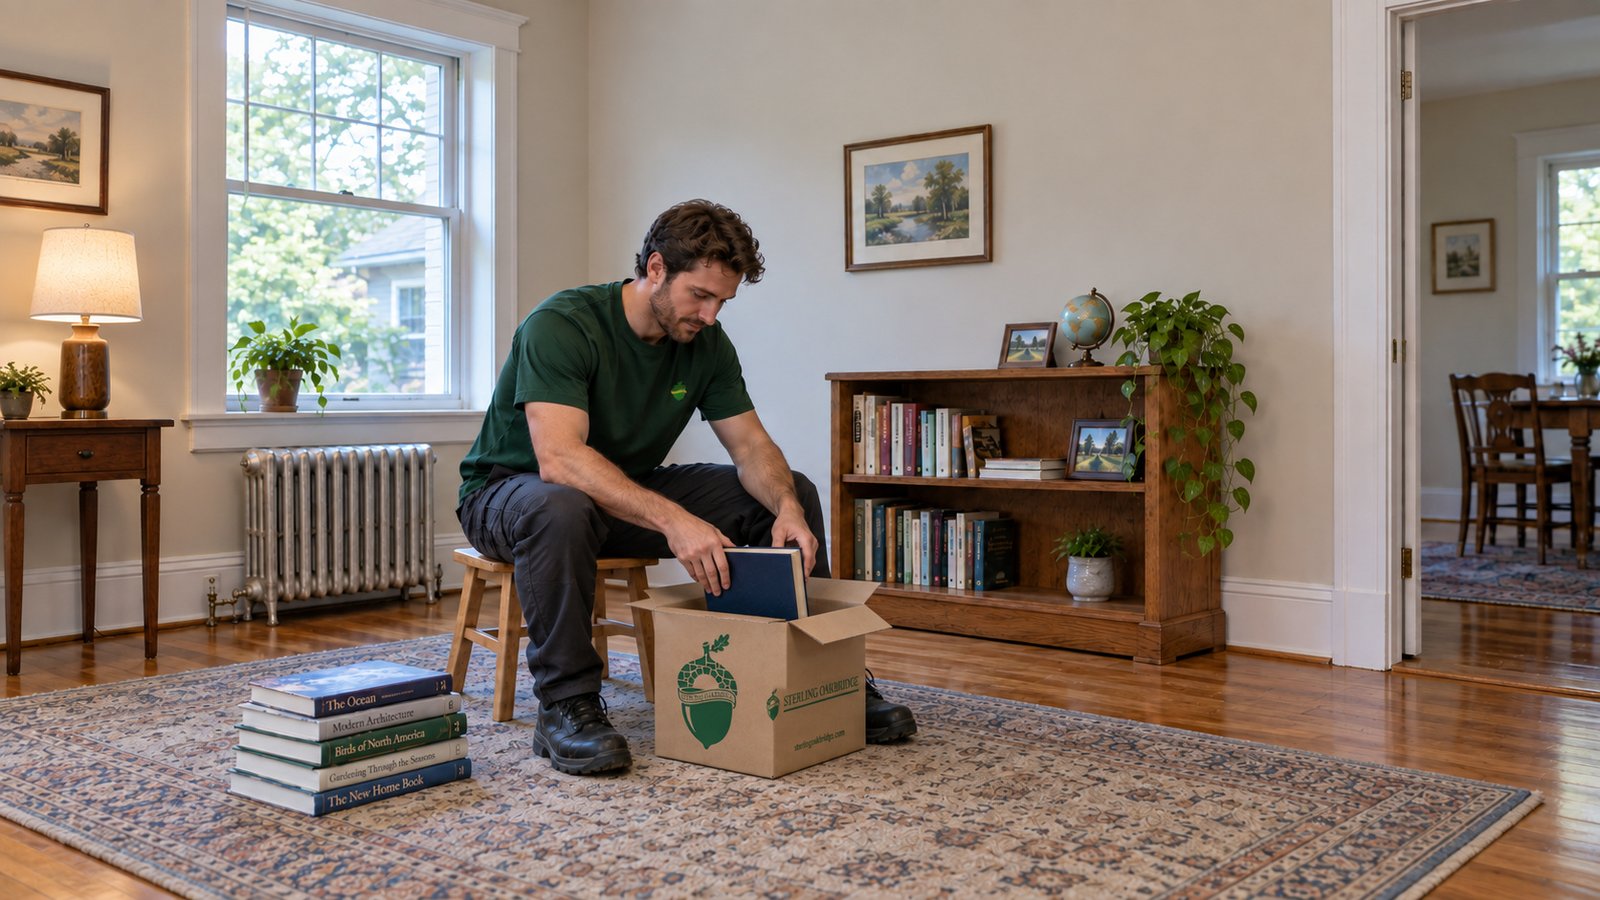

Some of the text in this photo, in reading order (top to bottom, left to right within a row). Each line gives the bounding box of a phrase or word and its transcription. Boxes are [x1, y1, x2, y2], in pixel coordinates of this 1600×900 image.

[326, 700, 345, 712] The
[347, 694, 376, 707] Ocean
[783, 676, 859, 707] STERLING OAKBRIDGE
[332, 709, 414, 733] Modern Architecture
[335, 731, 425, 757] Birds of North America
[329, 752, 436, 783] Gardening Through the Seasons
[328, 774, 424, 808] The New Home Book
